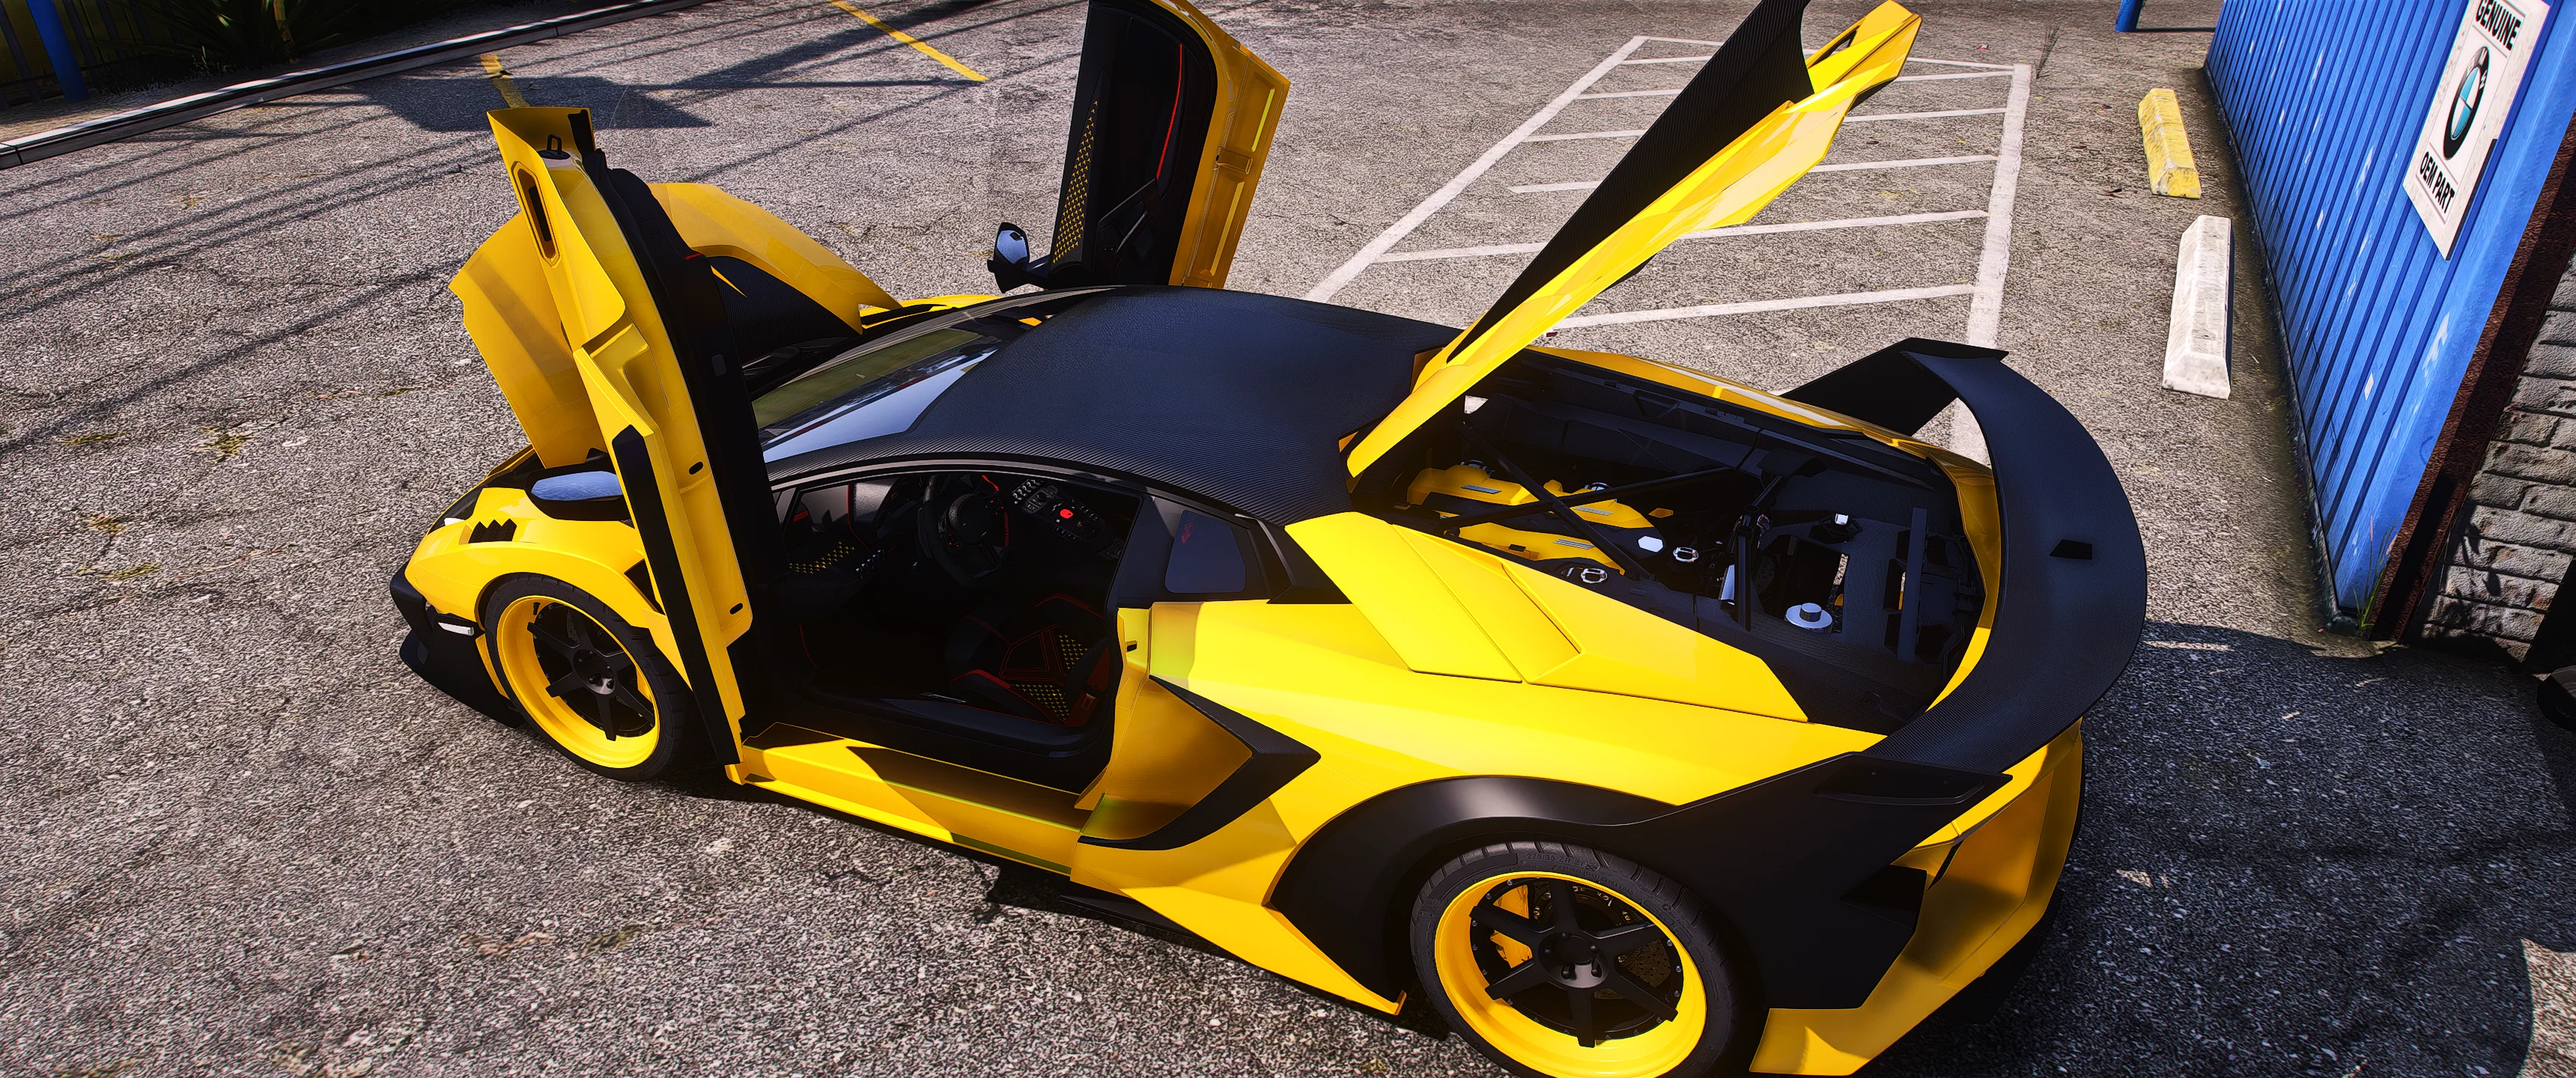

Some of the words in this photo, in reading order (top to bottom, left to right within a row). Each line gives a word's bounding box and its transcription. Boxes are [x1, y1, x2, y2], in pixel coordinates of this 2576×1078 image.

[2476, 0, 2521, 51] GENUINE
[2419, 151, 2438, 189] OEM
[2431, 171, 2455, 214] PART
